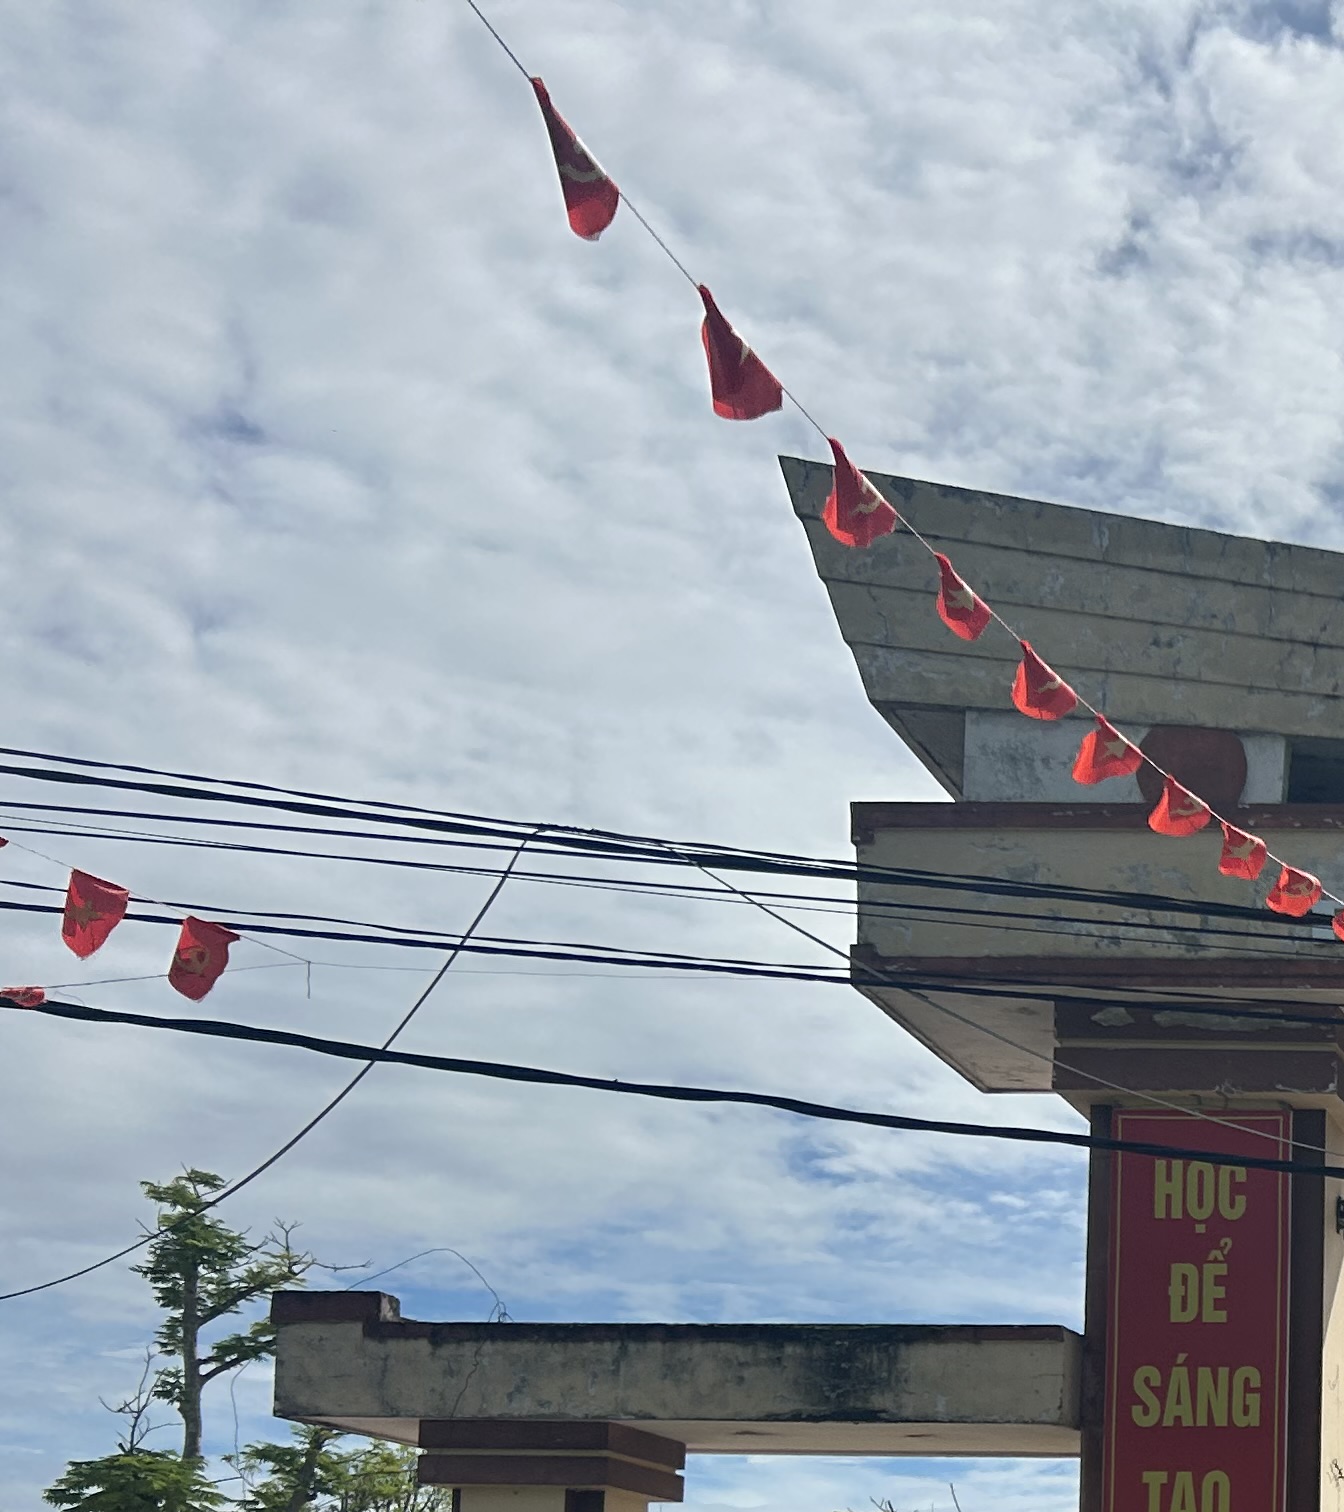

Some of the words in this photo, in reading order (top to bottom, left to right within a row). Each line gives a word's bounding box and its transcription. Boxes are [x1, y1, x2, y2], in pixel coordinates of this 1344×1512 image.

[1153, 1159, 1248, 1234] HỌC
[1168, 1237, 1234, 1324] ĐỂ
[1131, 1353, 1262, 1428] SÁNG
